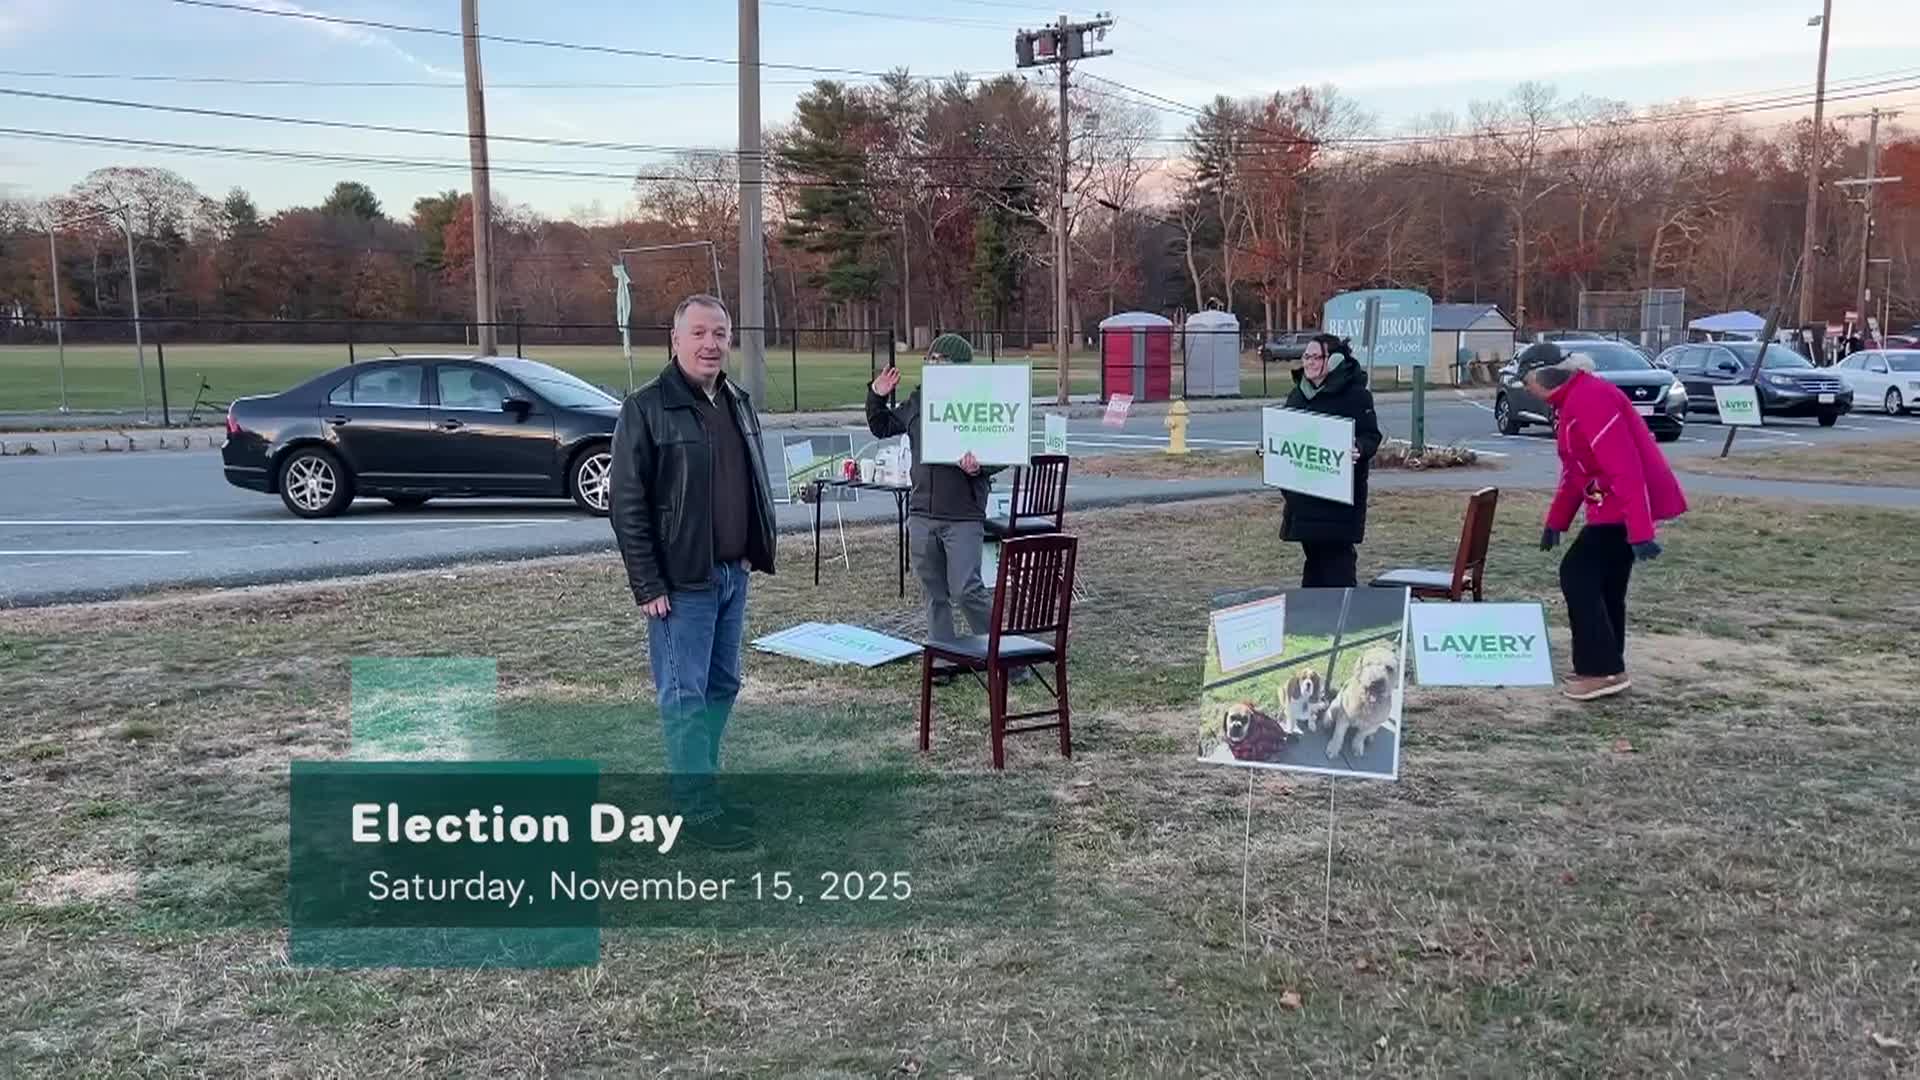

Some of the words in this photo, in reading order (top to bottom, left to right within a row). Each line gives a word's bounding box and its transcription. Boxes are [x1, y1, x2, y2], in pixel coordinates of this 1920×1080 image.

[1329, 319, 1371, 337] BEAV
[1381, 317, 1426, 337] BROOK
[929, 402, 1020, 423] LAVERY
[953, 425, 970, 433] FOR
[971, 425, 1015, 433] ABINGTON
[1268, 437, 1345, 468] LAVERY
[1305, 463, 1341, 475] ABINGTON
[1423, 634, 1536, 652] LAVERY
